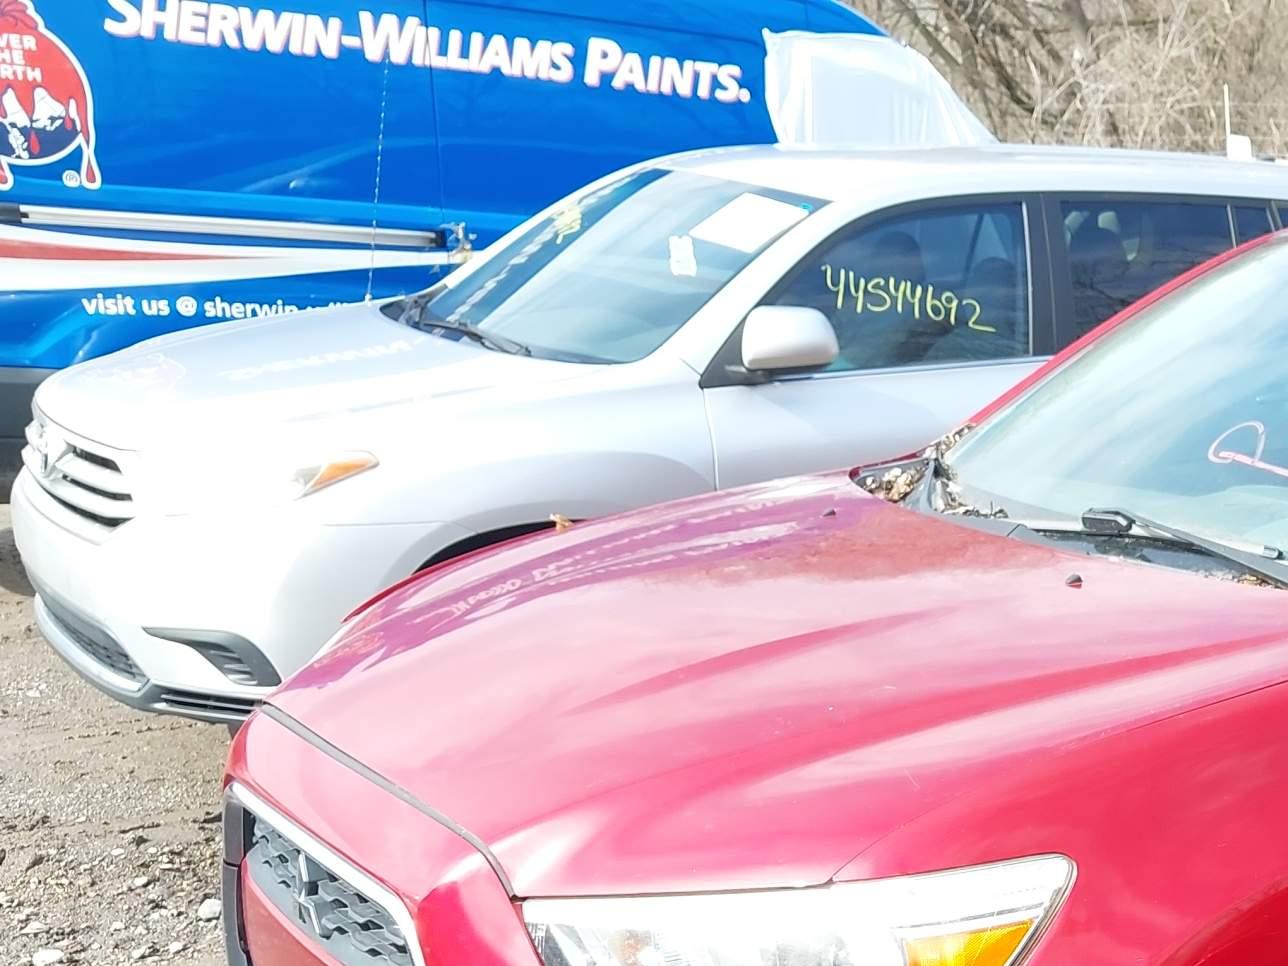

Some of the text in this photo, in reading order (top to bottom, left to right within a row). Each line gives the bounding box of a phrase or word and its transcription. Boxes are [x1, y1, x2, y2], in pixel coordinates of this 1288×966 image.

[0, 32, 37, 51] VER
[104, 0, 575, 83] SHERWIN-WILLIAMS
[0, 48, 26, 66] HE
[0, 64, 43, 83] RTH
[81, 294, 135, 316] visit
[142, 298, 170, 316] us
[176, 295, 197, 317] @
[822, 265, 996, 333] 44544692
